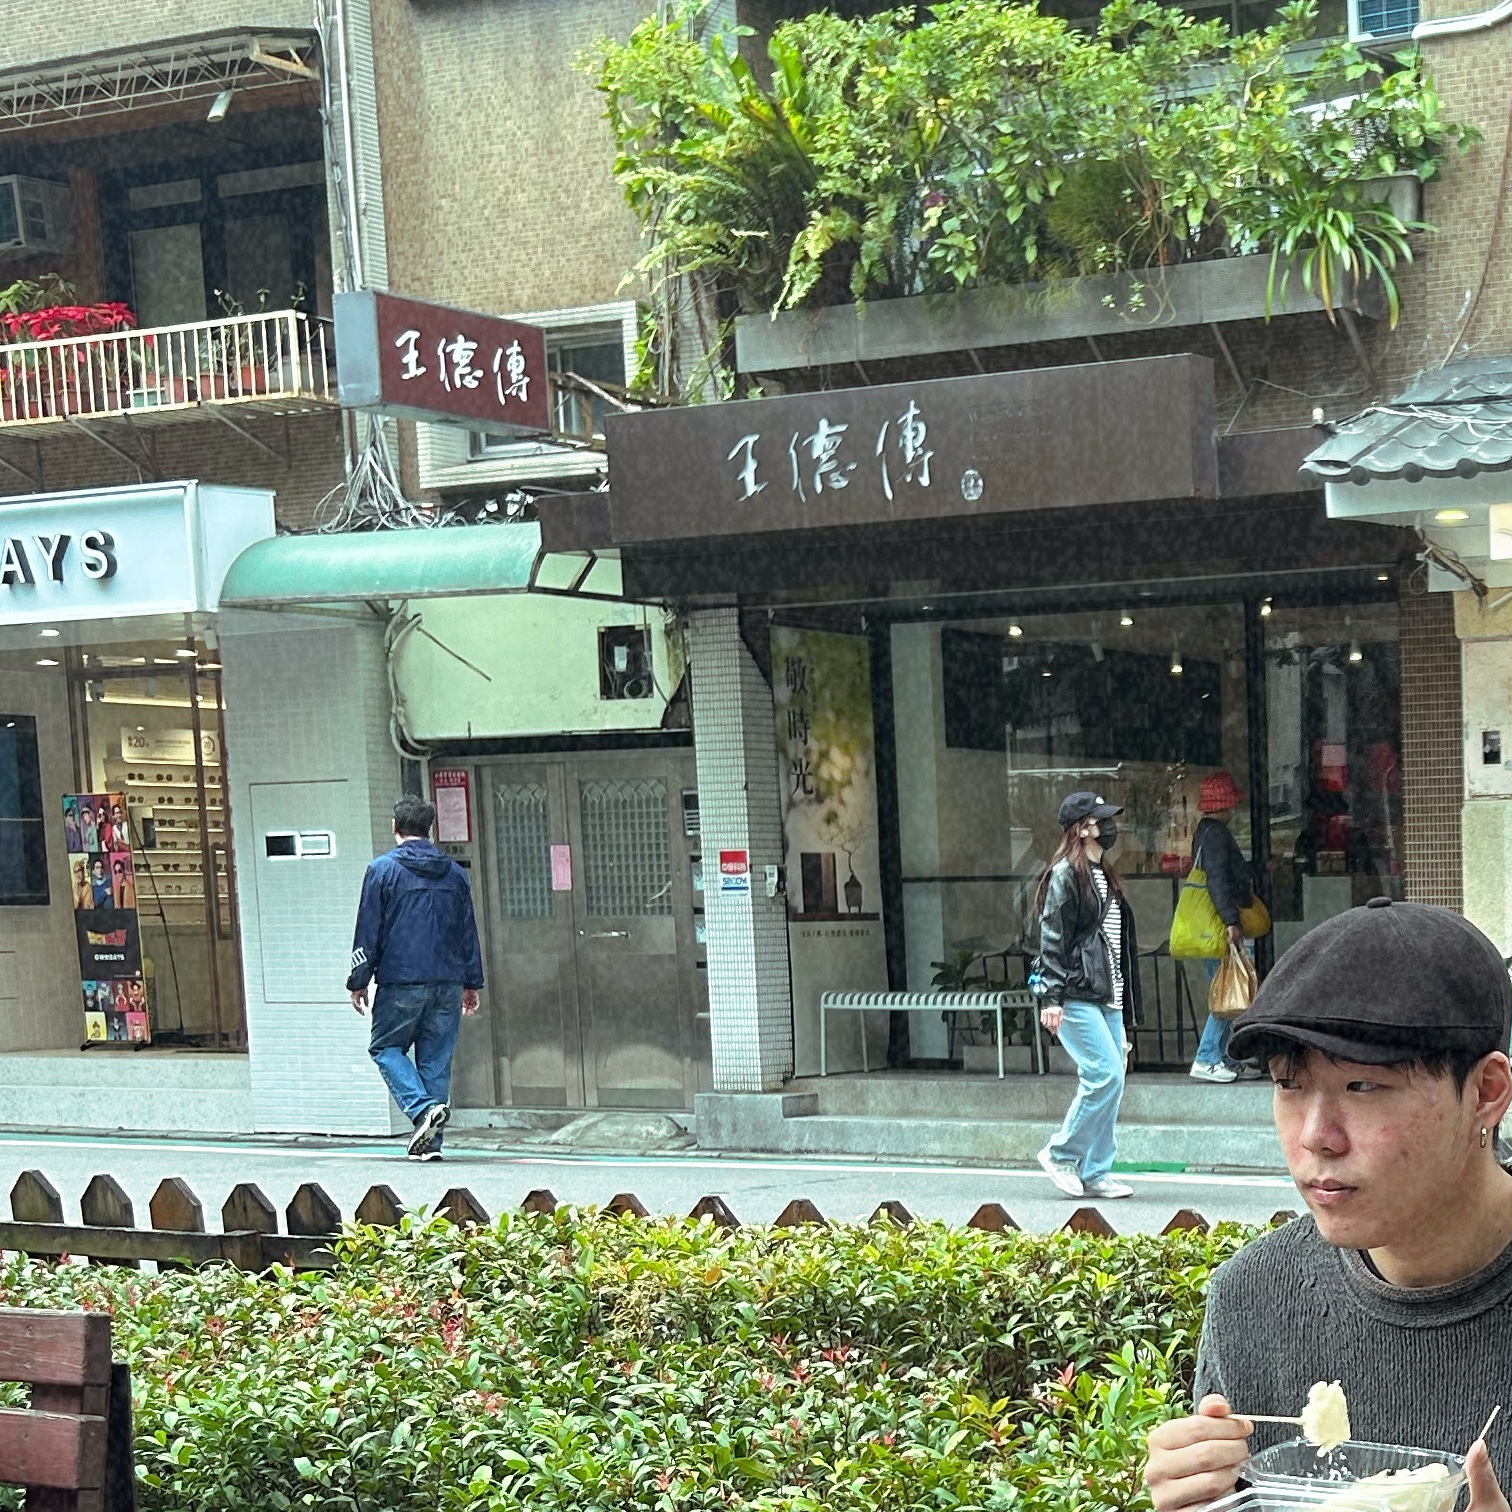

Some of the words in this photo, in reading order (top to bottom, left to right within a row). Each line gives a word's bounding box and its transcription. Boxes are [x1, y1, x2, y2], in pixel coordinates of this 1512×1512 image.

[394, 329, 531, 406] 王德傳
[726, 399, 936, 504] 王德傳
